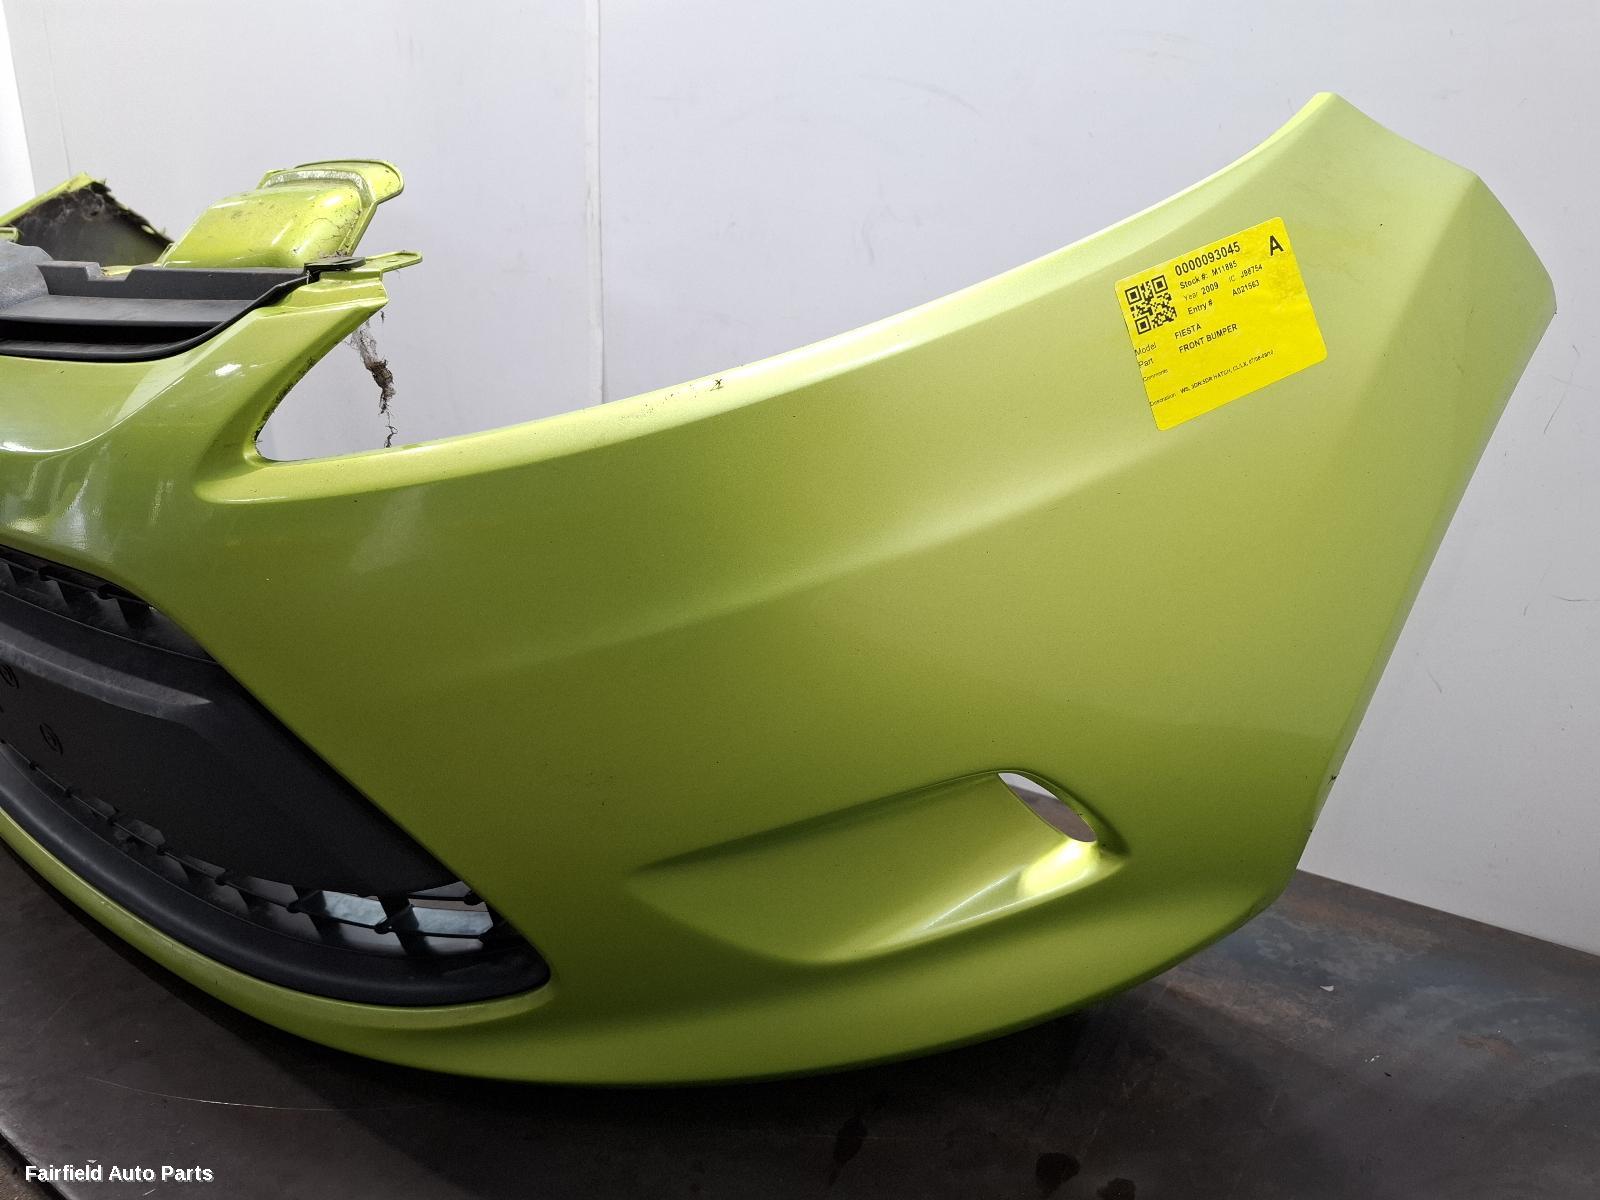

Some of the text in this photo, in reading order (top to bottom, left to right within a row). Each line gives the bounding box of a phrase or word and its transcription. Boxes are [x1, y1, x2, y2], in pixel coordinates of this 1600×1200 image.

[1269, 235, 1284, 256] A
[1175, 241, 1241, 276] 0000093045
[1179, 276, 1200, 289] Stock
[1211, 259, 1238, 276] M11885
[1201, 281, 1219, 295] 2009
[1187, 303, 1207, 315] Entry
[1174, 322, 1202, 339] FIESTA
[1178, 323, 1238, 353] FRONT BUMPER
[1135, 342, 1157, 356] Model
[1138, 358, 1154, 368] Part
